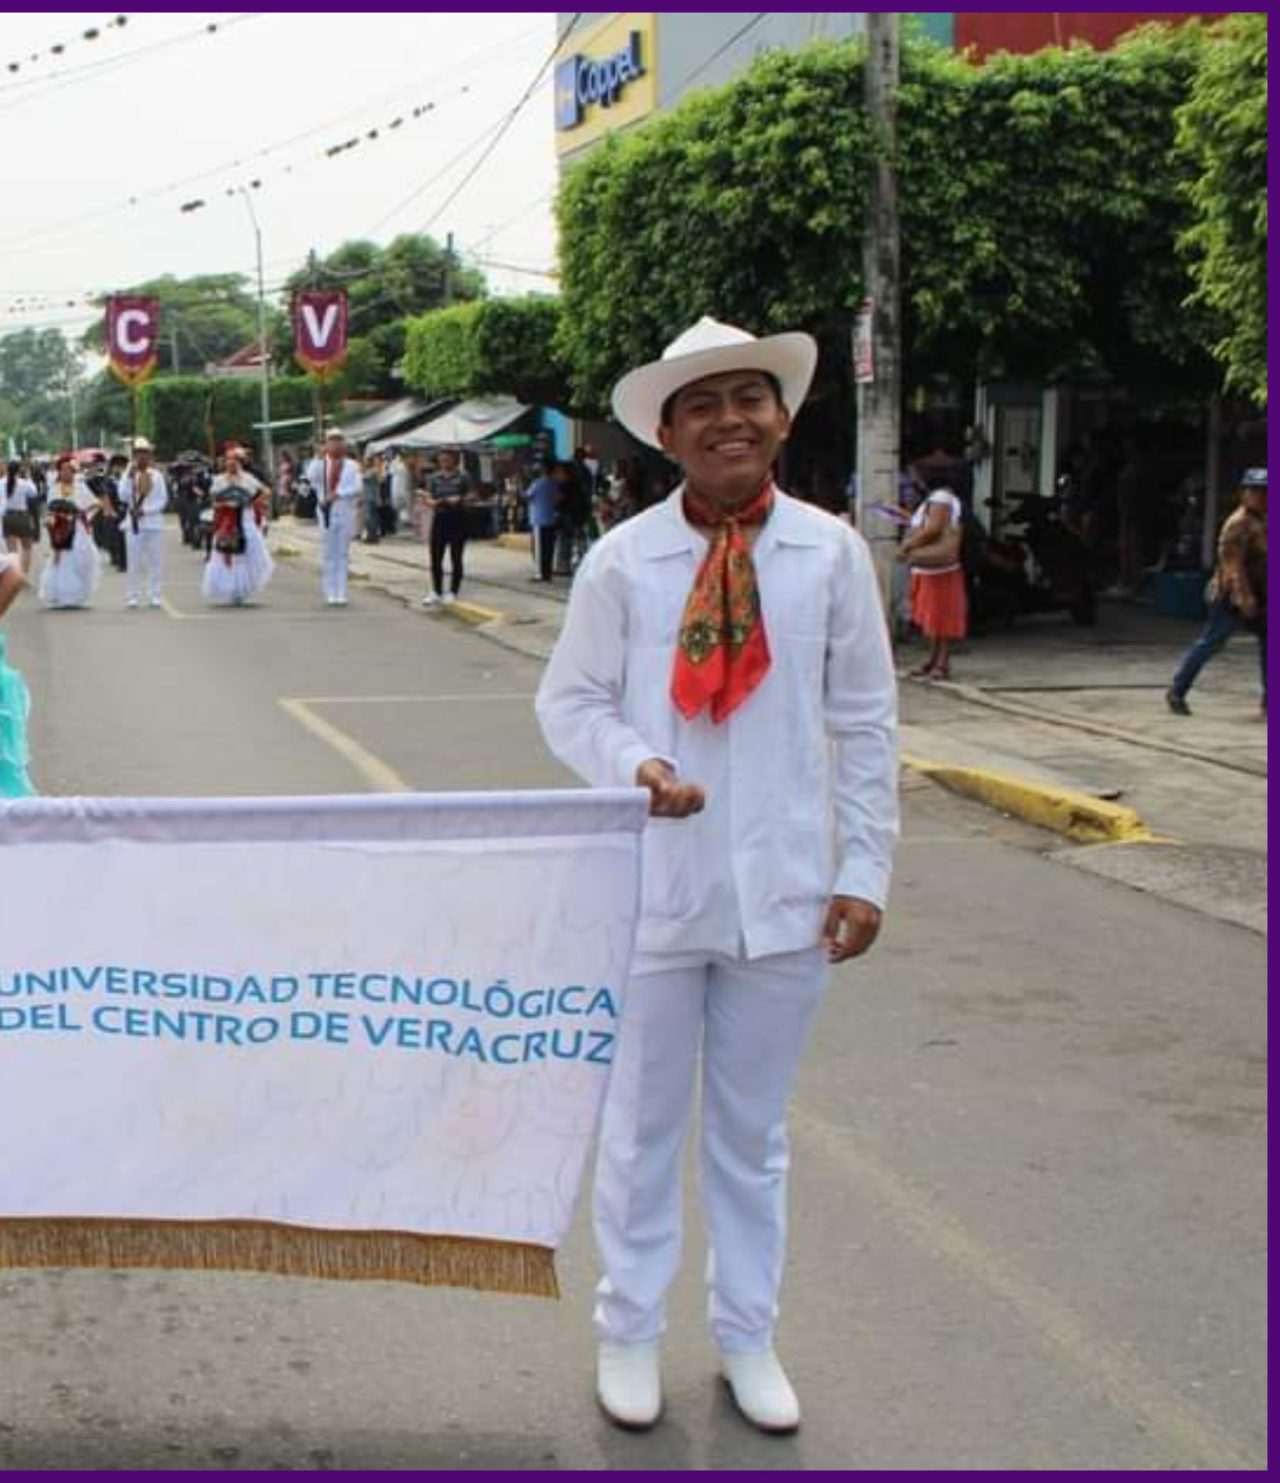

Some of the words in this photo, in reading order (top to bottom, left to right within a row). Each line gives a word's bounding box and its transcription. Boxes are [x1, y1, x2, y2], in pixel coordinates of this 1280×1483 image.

[577, 30, 646, 108] Coppel
[116, 310, 149, 353] C
[302, 305, 337, 347] V
[308, 972, 618, 1019] TECNOLÓGICA
[92, 1008, 279, 1045] CENTRO
[290, 1010, 350, 1043] DE
[360, 1014, 616, 1065] VERACRUZ
